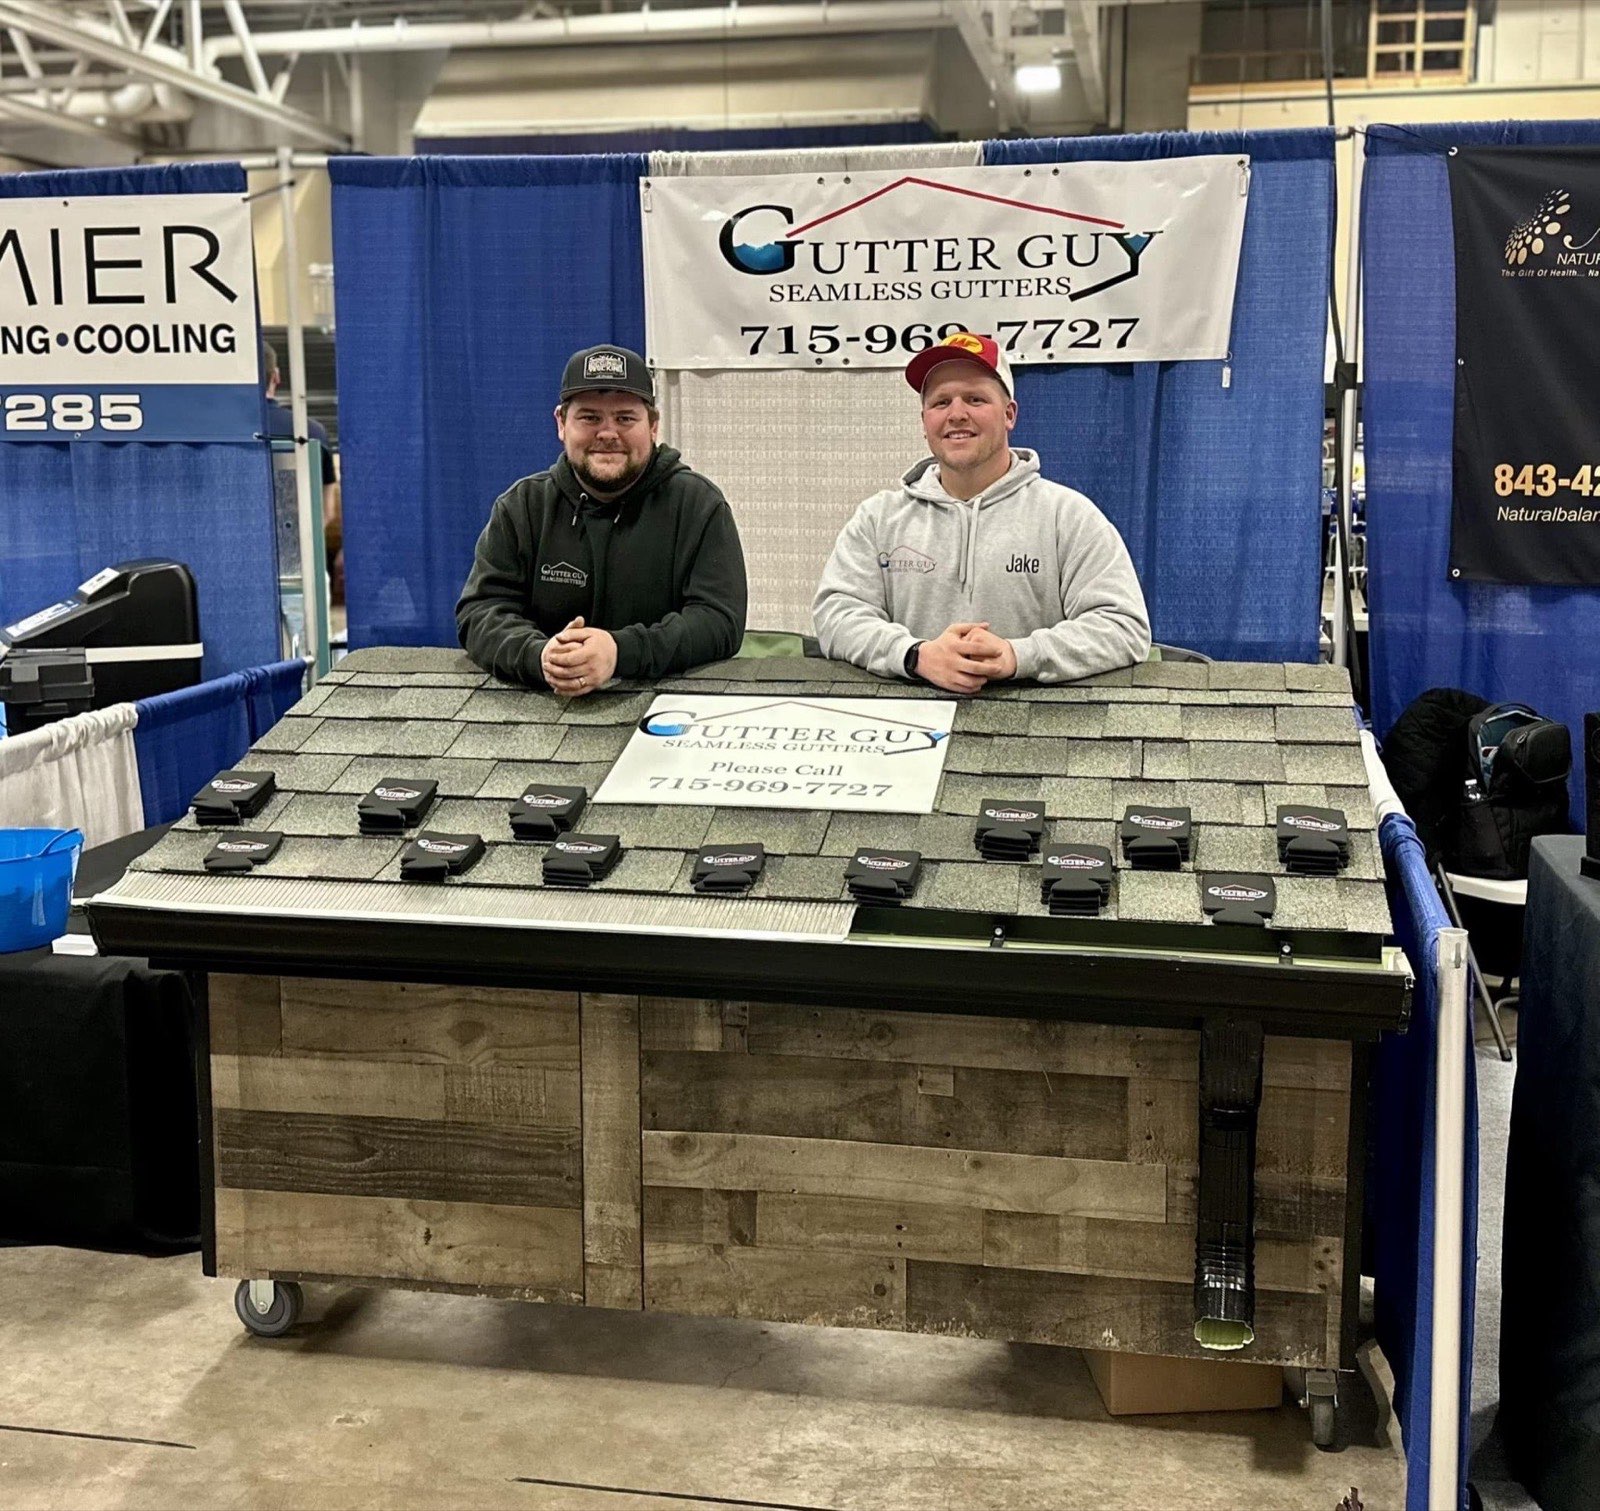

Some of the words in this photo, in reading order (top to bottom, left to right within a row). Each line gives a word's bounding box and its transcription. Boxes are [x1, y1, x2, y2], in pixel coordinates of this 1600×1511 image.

[719, 204, 1001, 276] GUTTER
[1017, 230, 1164, 302] GUY
[1501, 269, 1515, 277] The
[1518, 269, 1535, 277] Gift
[1537, 269, 1548, 277] Of
[769, 282, 922, 302] SEAMLESS
[930, 276, 1071, 299] GUTTERS
[1005, 553, 1040, 574] Jake
[638, 710, 837, 742] GUTTER
[849, 729, 950, 756] GUY
[662, 739, 778, 751] SEAMLESS
[783, 742, 886, 754] GUTTERS
[708, 762, 788, 774] Please
[795, 764, 843, 776] Call
[649, 776, 893, 797] 715-969-7727
